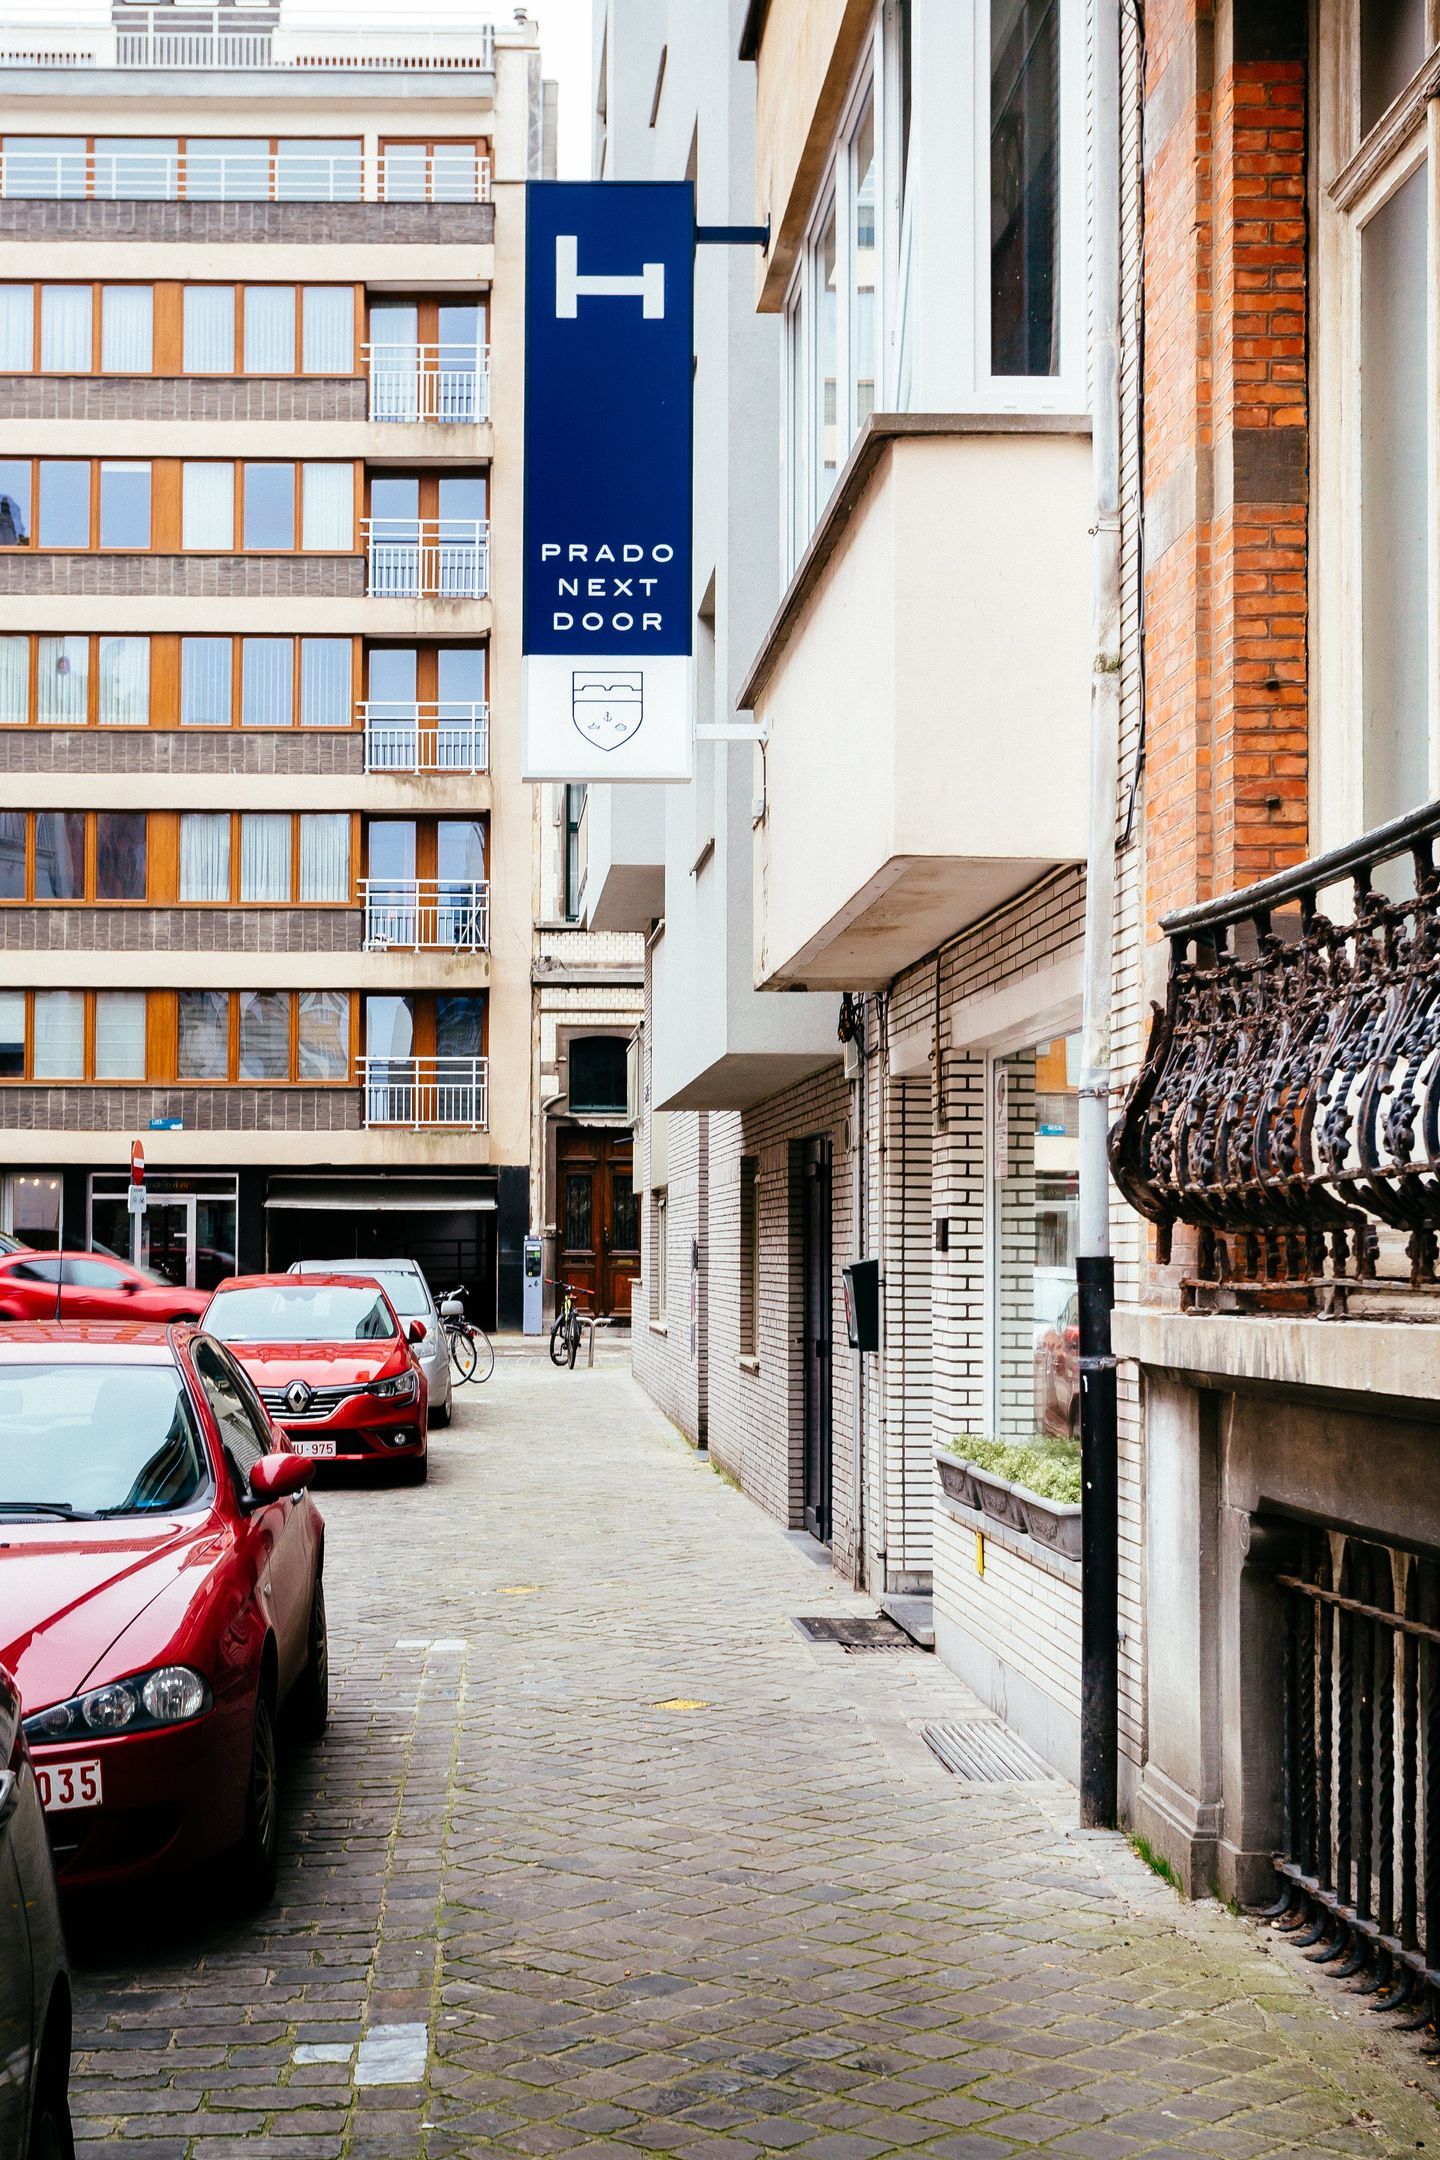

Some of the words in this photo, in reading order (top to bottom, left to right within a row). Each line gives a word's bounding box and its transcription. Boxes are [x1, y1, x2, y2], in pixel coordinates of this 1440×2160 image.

[541, 543, 674, 563] PRADO
[558, 578, 658, 597] NEXT
[553, 612, 662, 631] DOOR
